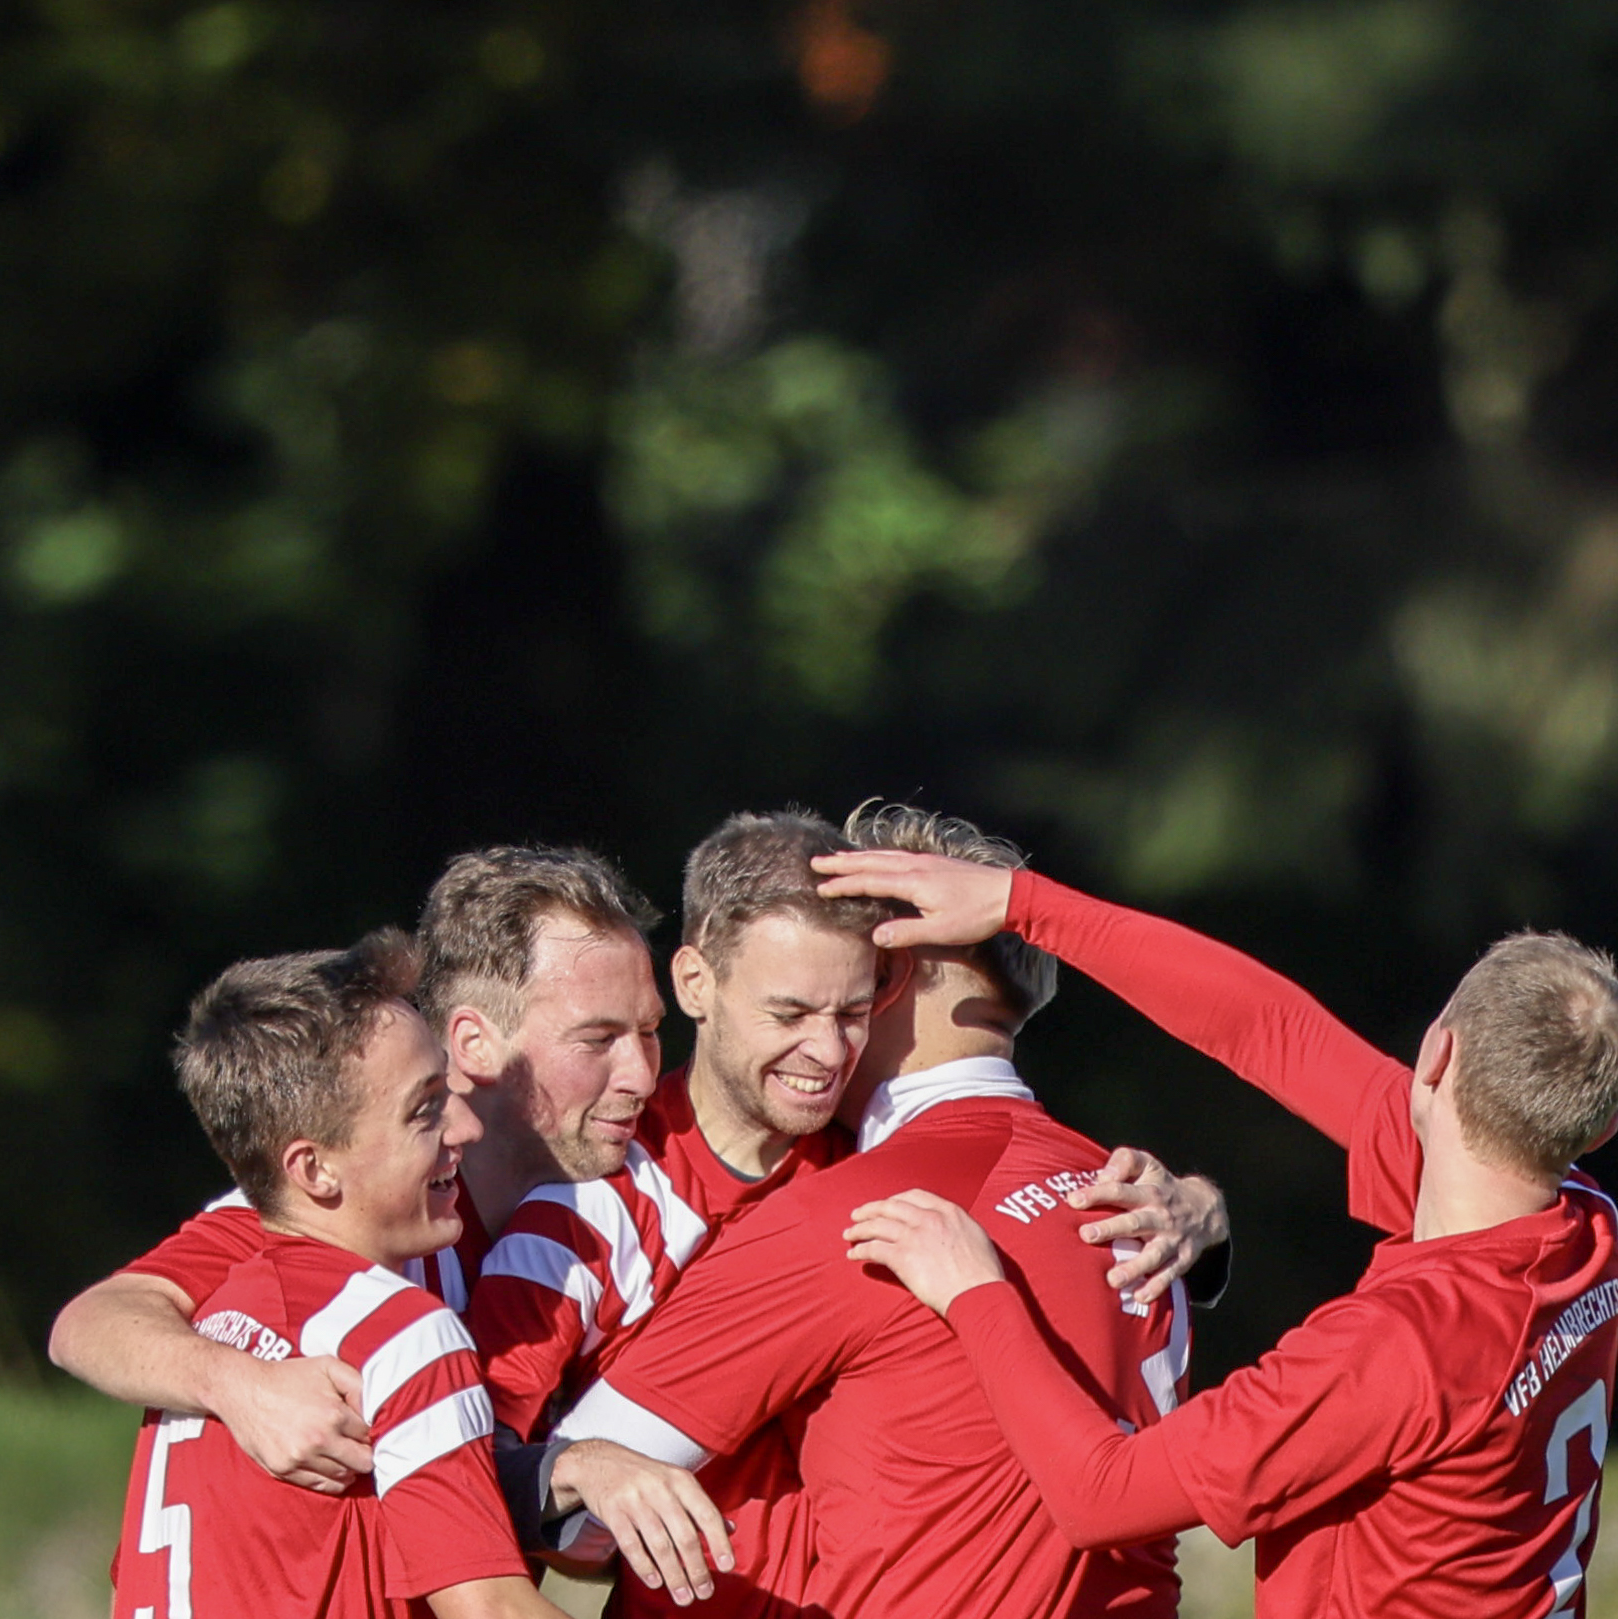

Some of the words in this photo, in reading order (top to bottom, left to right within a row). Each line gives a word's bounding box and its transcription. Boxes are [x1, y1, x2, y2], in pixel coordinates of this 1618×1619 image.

[995, 1183, 1058, 1224] VFB
[251, 1326, 292, 1361] 98
[1504, 1361, 1542, 1417] VFB
